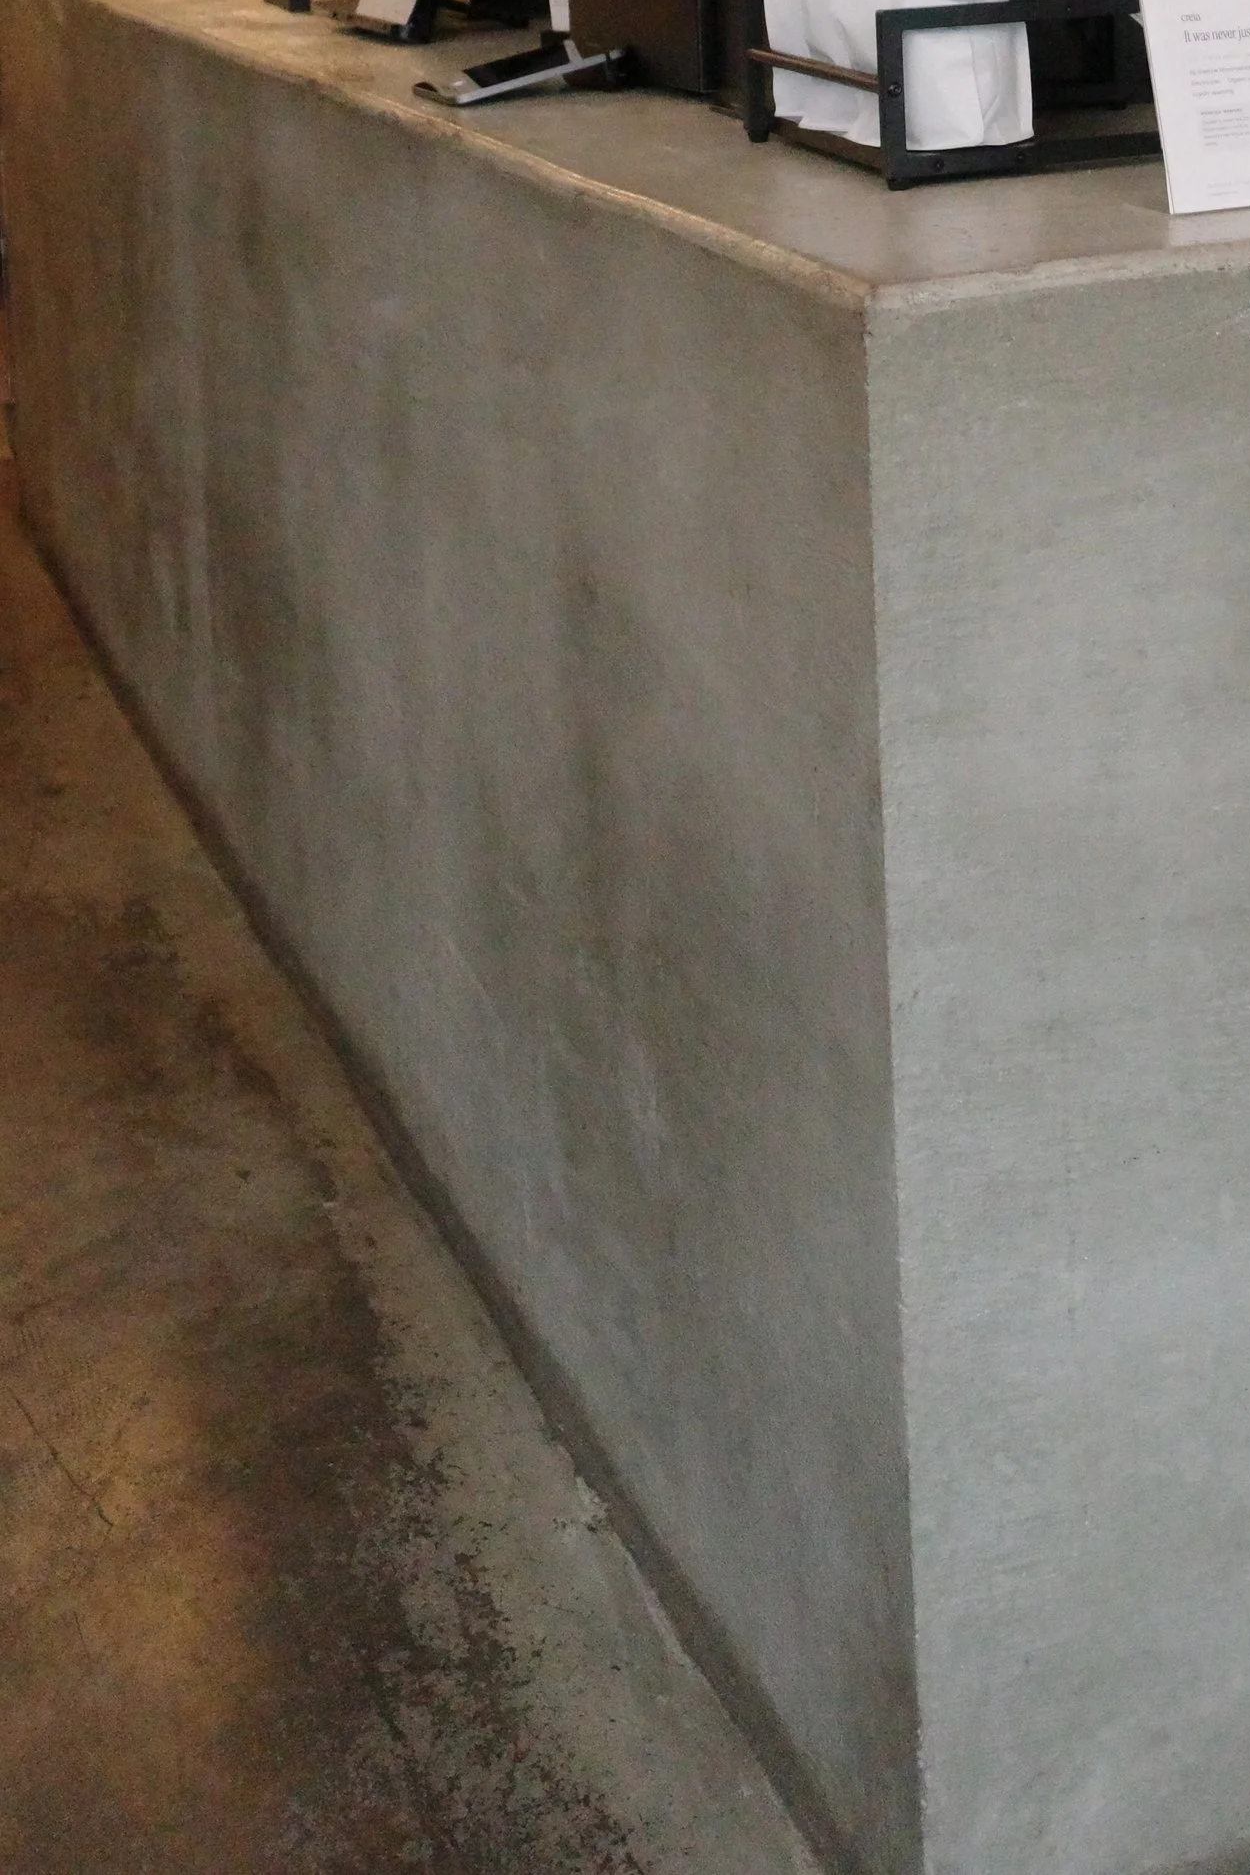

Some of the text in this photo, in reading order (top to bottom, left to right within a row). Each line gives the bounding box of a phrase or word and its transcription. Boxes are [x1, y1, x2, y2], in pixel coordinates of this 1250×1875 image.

[1184, 30, 1191, 43] It
[1193, 32, 1211, 42] was
[1212, 29, 1236, 40] never
